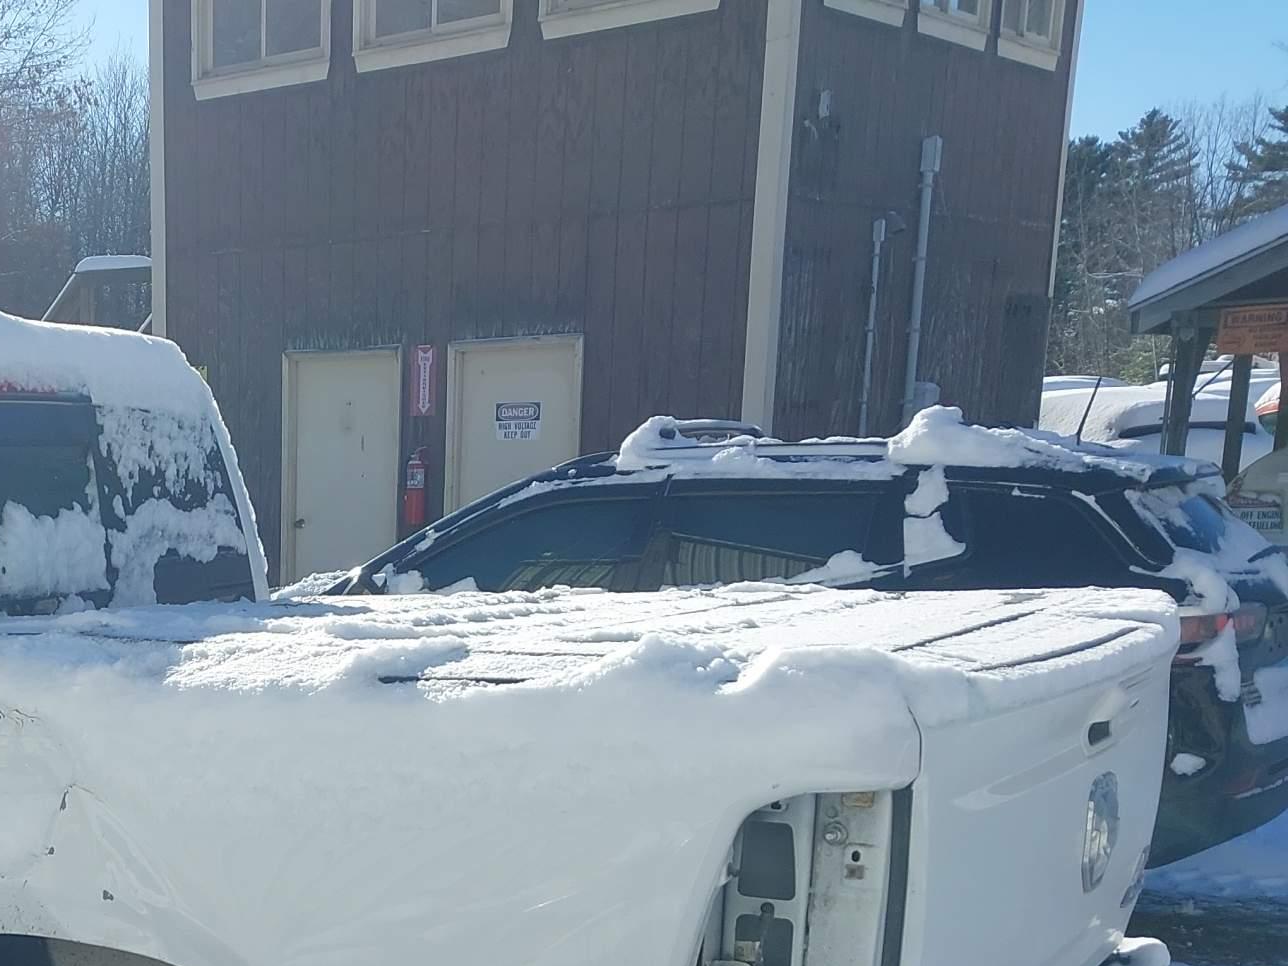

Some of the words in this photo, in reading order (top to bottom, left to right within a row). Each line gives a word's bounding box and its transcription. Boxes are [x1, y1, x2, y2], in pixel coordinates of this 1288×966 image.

[501, 407, 535, 417] DANGER
[503, 430, 518, 439] KEEP
[520, 430, 531, 439] OUT
